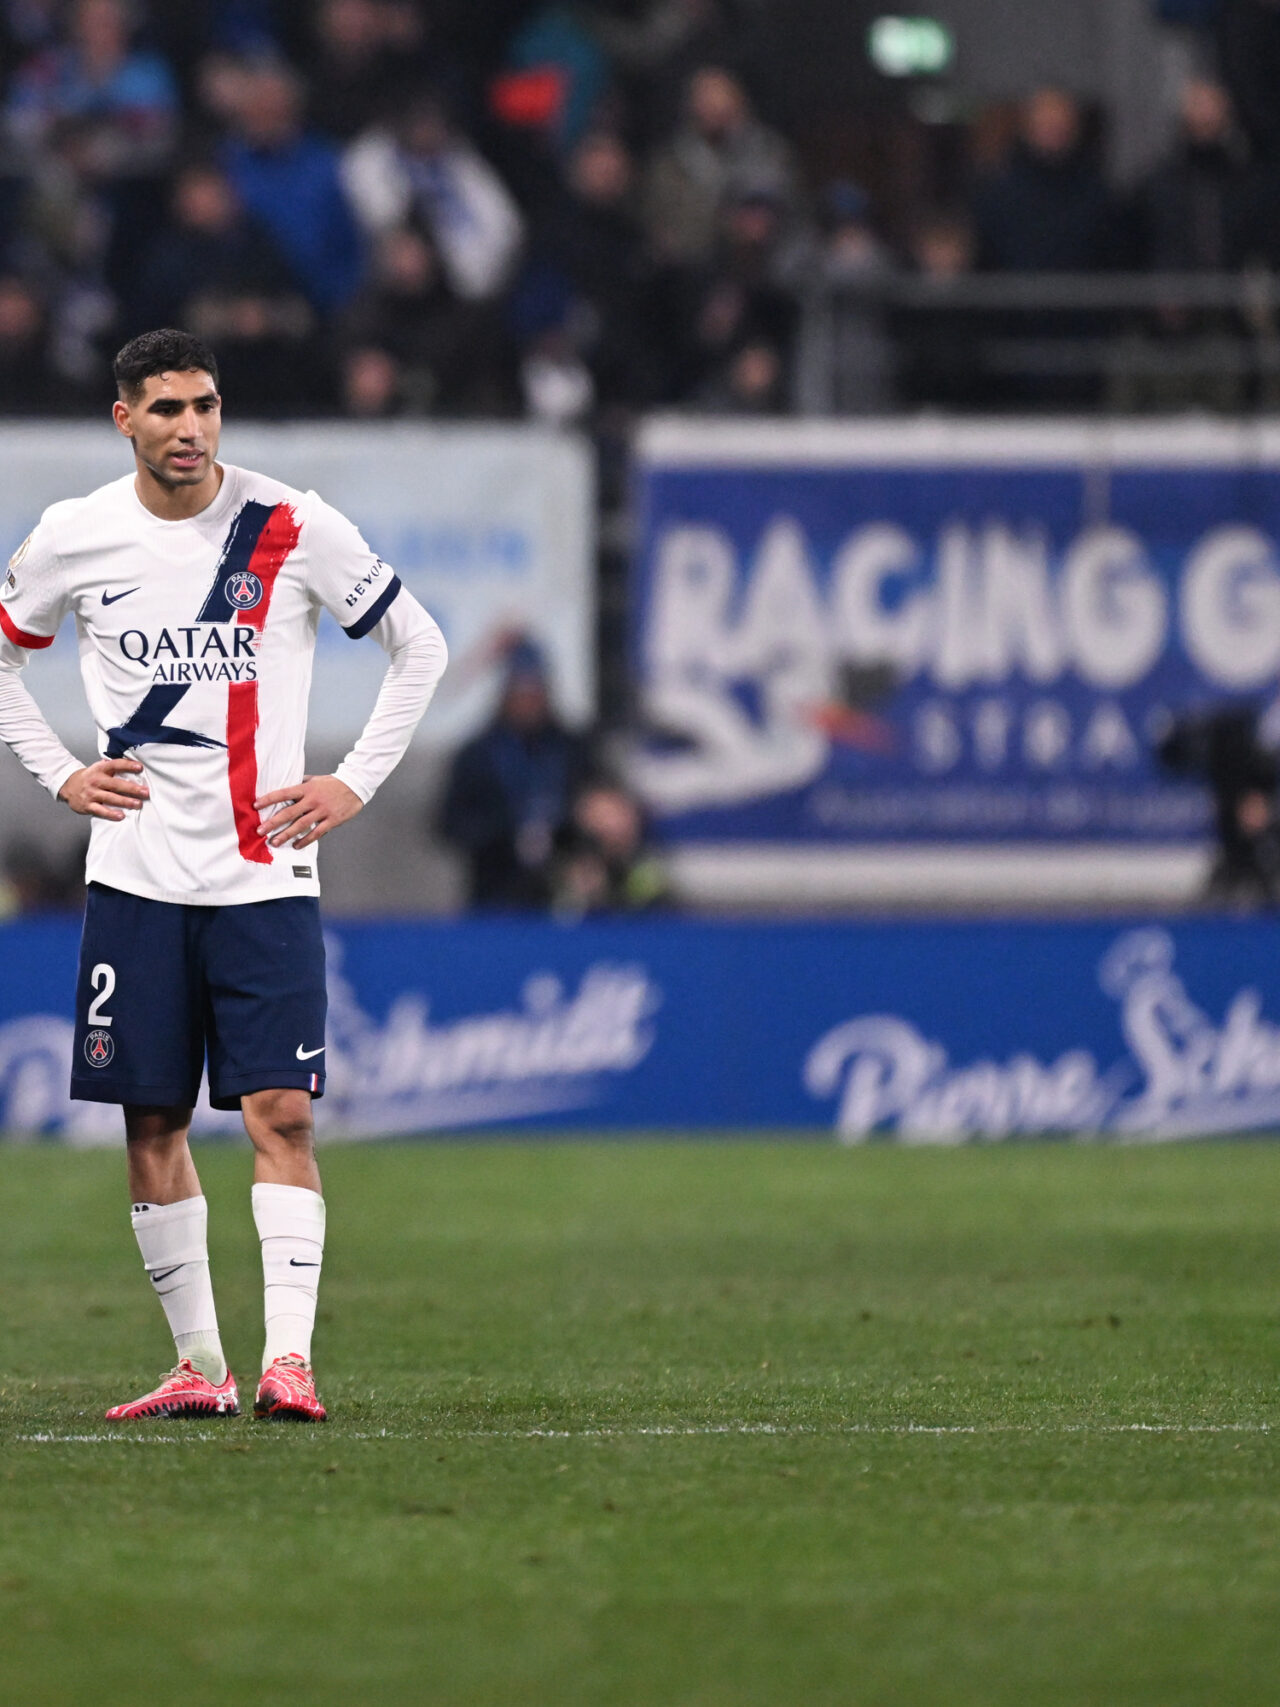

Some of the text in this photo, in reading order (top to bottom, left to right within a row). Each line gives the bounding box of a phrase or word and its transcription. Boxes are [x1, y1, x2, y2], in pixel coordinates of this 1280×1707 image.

[231, 573, 256, 583] PARIS
[646, 514, 1167, 689] RACING
[119, 627, 256, 668] QATAR
[152, 661, 257, 682] AIRWAYS
[87, 963, 116, 1027] 2
[89, 1031, 110, 1042] PARIS
